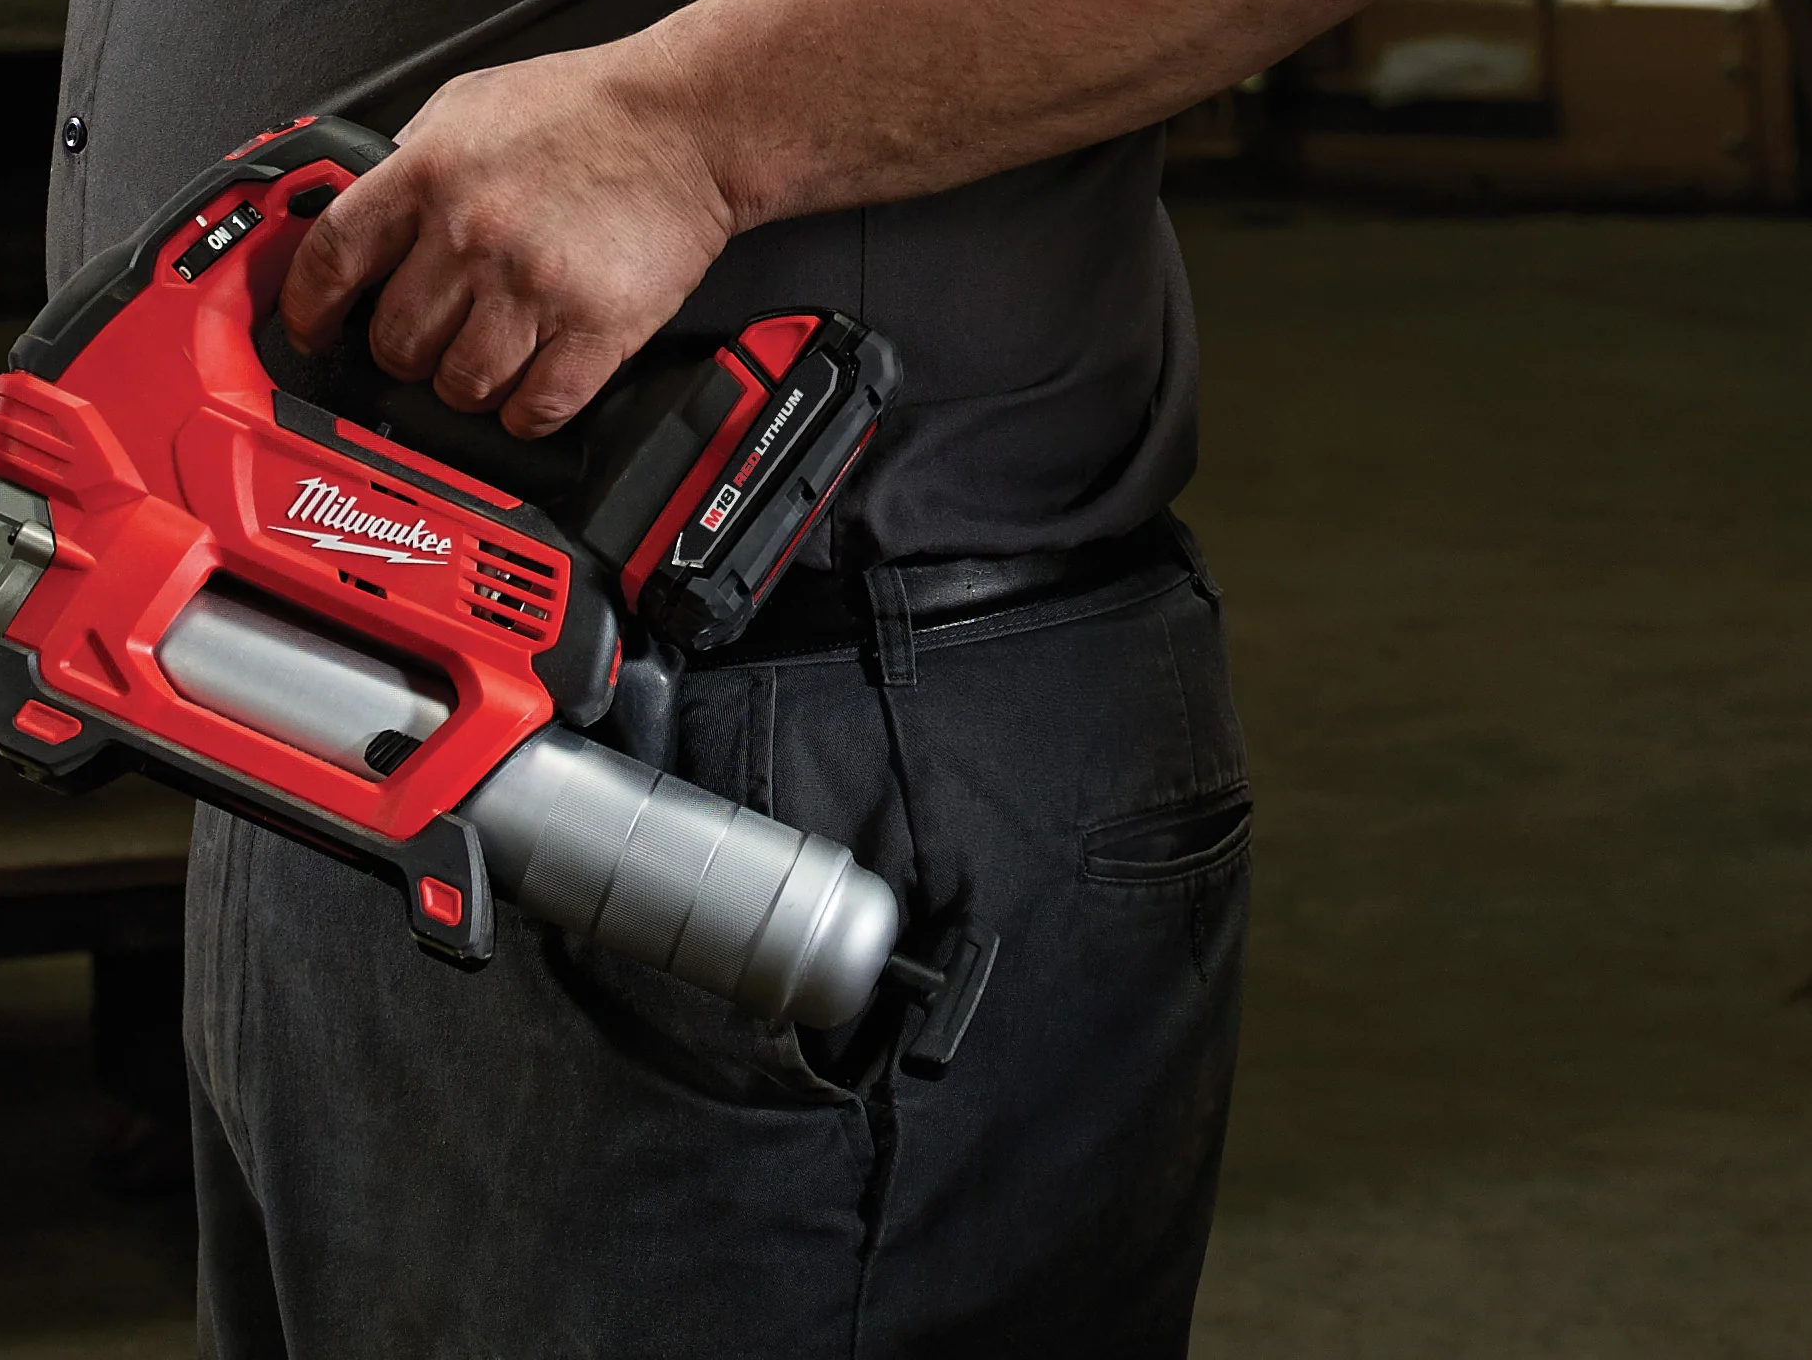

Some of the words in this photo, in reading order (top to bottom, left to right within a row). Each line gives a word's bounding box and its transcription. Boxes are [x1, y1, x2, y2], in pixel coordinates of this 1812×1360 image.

[207, 226, 233, 250] ON
[232, 215, 246, 230] 1
[703, 488, 736, 530] M18
[733, 388, 804, 488] REDLITHIUM
[287, 477, 452, 555] Milwaukee
